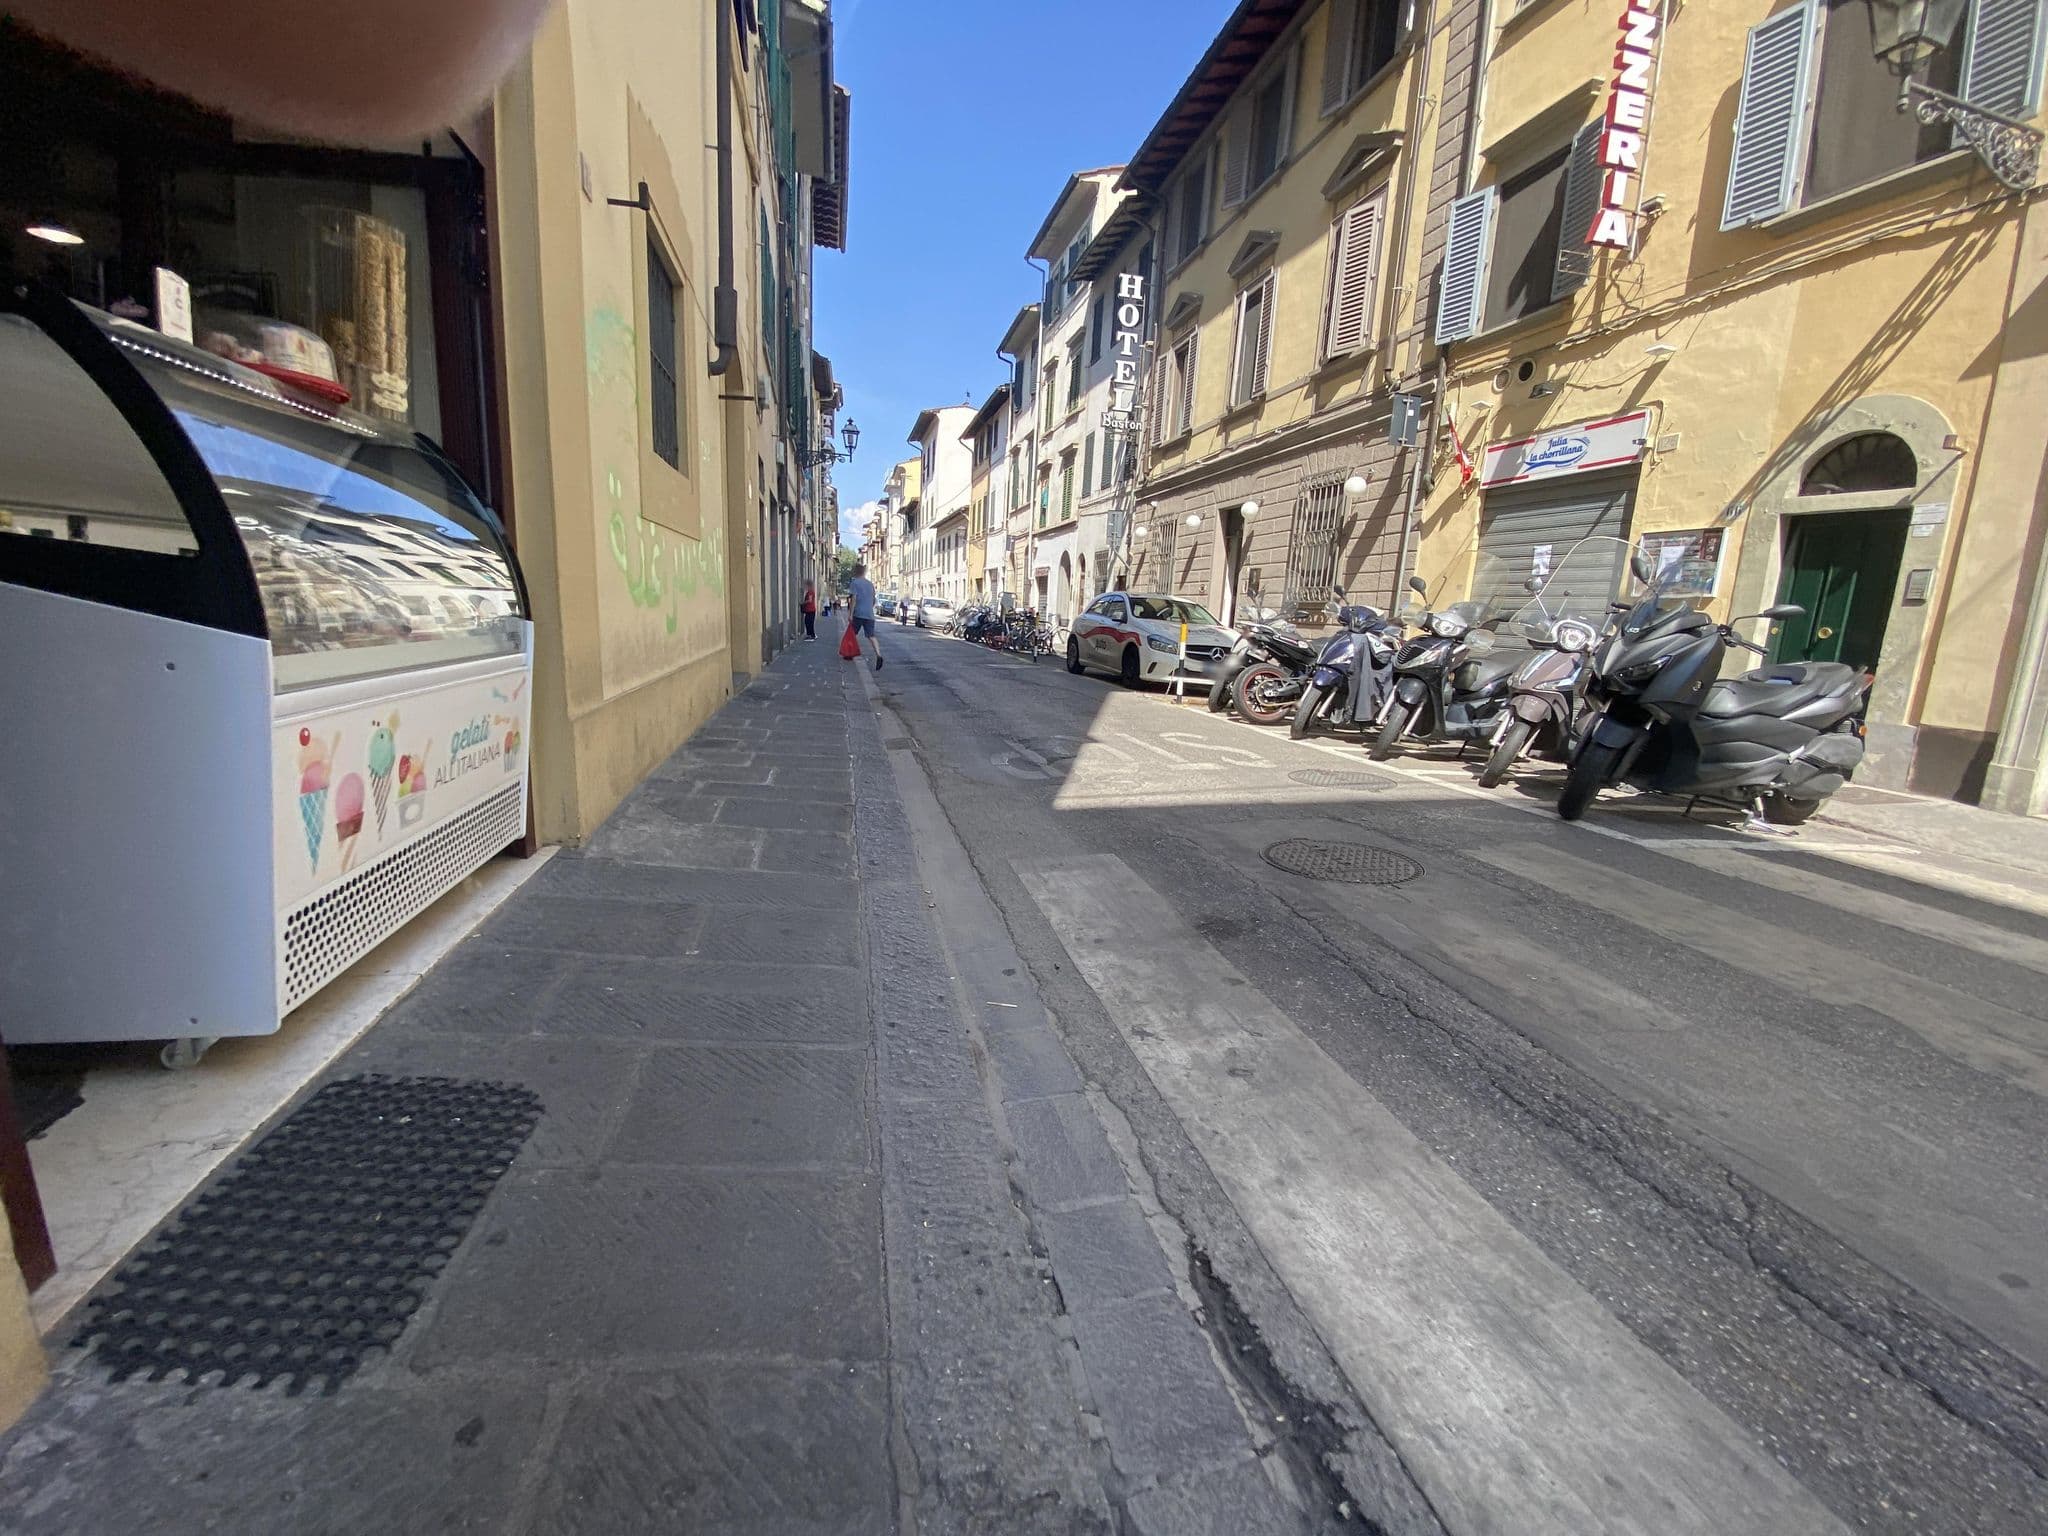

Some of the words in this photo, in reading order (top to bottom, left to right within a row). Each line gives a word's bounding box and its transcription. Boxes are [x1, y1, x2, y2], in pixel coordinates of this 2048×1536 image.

[1589, 0, 1657, 246] ZZERIA
[1112, 273, 1143, 412] HOTEL
[1530, 453, 1538, 461] la
[1548, 437, 1568, 451] Julia
